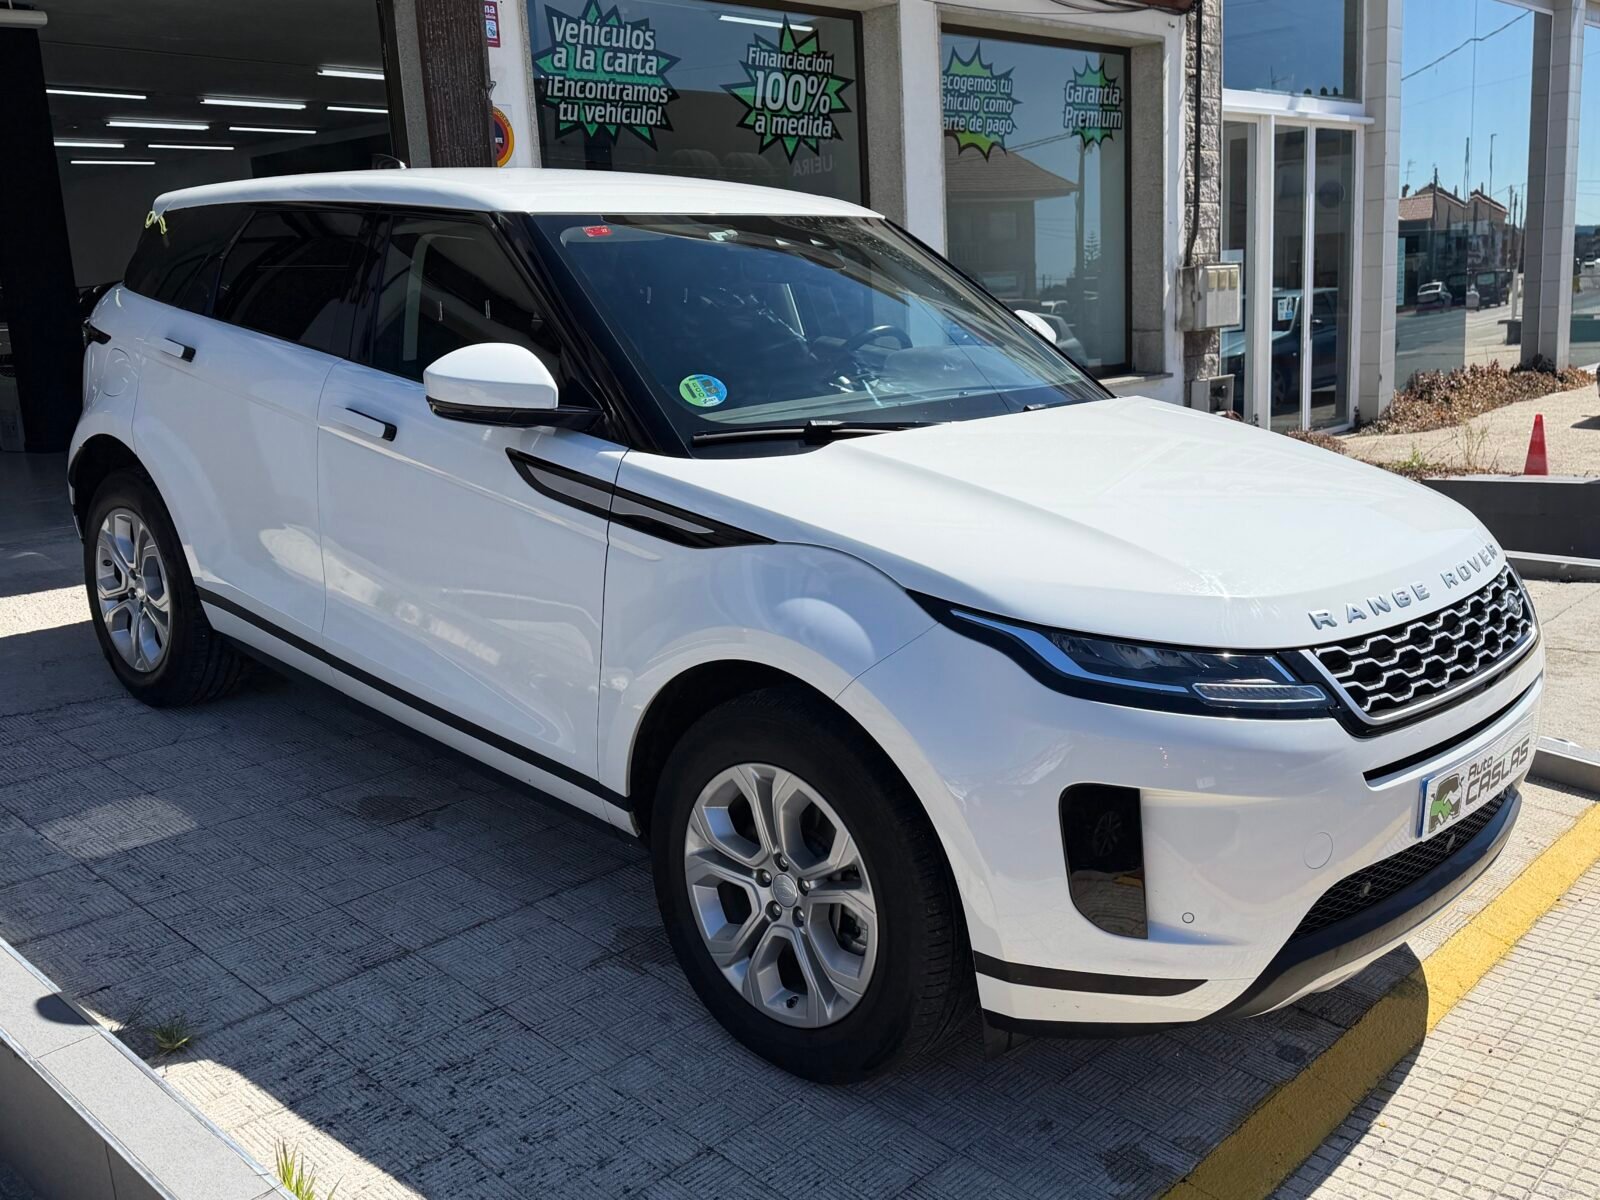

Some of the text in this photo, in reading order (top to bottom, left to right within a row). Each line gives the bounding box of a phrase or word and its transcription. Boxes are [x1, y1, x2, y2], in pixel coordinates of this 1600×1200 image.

[552, 16, 656, 51] Vehículos
[553, 44, 658, 76] a la carta
[748, 46, 834, 74] Financiación
[754, 70, 832, 114] 100%
[942, 75, 1012, 93] ecogemos tu
[1065, 81, 1121, 105] Garantía
[559, 101, 663, 126] tu vehículo!
[983, 99, 1013, 113] como
[1064, 105, 1122, 129] Premium
[755, 115, 833, 138] a medida
[943, 115, 1013, 135] arte de pago
[1308, 543, 1498, 630] RANGE ROVER
[1465, 737, 1530, 806] CASLAS
[1468, 755, 1494, 782] Auto
